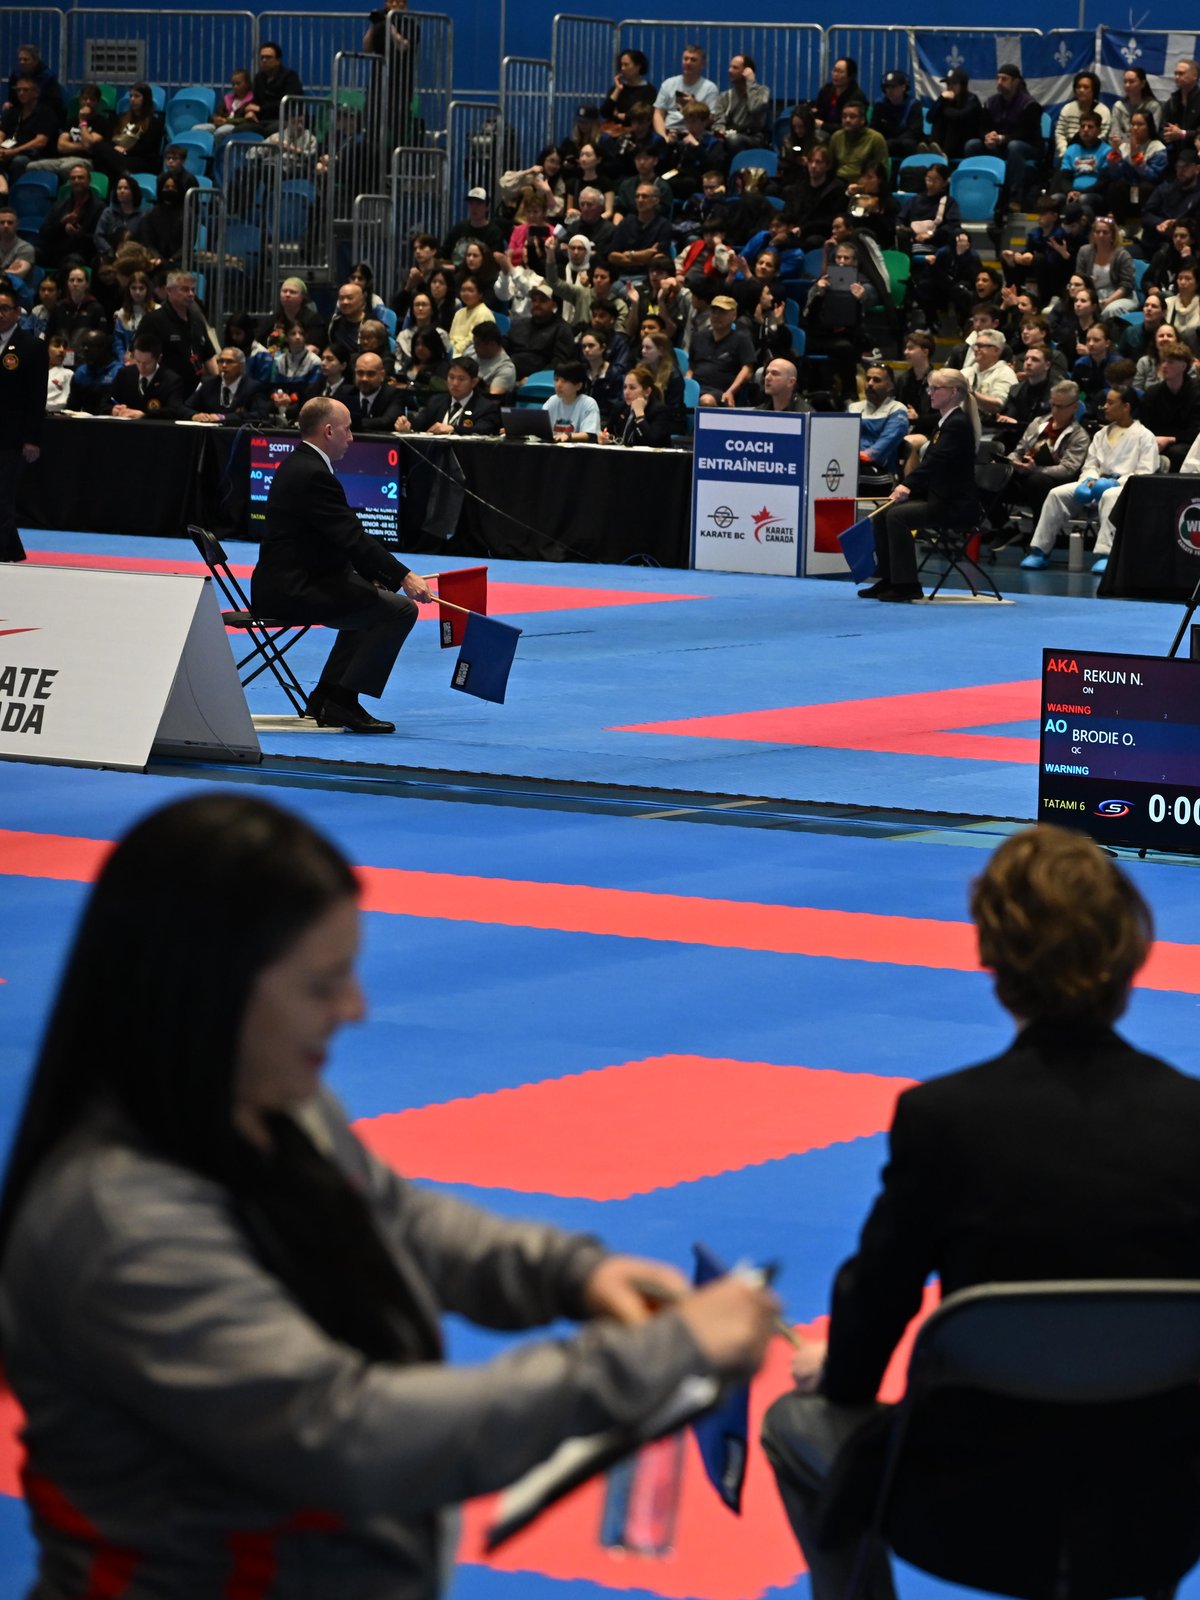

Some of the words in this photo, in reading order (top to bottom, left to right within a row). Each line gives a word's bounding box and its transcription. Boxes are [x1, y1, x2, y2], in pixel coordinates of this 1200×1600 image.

[269, 443, 290, 452] SCOTT
[725, 440, 773, 454] COACH
[388, 449, 399, 466] 0
[250, 470, 262, 480] AO
[700, 530, 732, 540] KARATE
[734, 532, 745, 540] BC
[766, 527, 794, 536] KARATE
[766, 534, 794, 543] CANADA
[1047, 659, 1079, 674] AKA
[1084, 669, 1126, 684] REKUN
[1131, 673, 1144, 686] N.
[0, 666, 60, 700] ATE
[1082, 686, 1094, 695] ON
[1047, 703, 1092, 715] WARNING
[1045, 719, 1067, 734] AO
[1072, 729, 1119, 745] BRODIE
[1122, 734, 1136, 746] O.
[1071, 747, 1082, 755] QC
[1045, 763, 1089, 775] WARNING
[1043, 799, 1078, 810] TATAMI
[1079, 802, 1085, 811] 6
